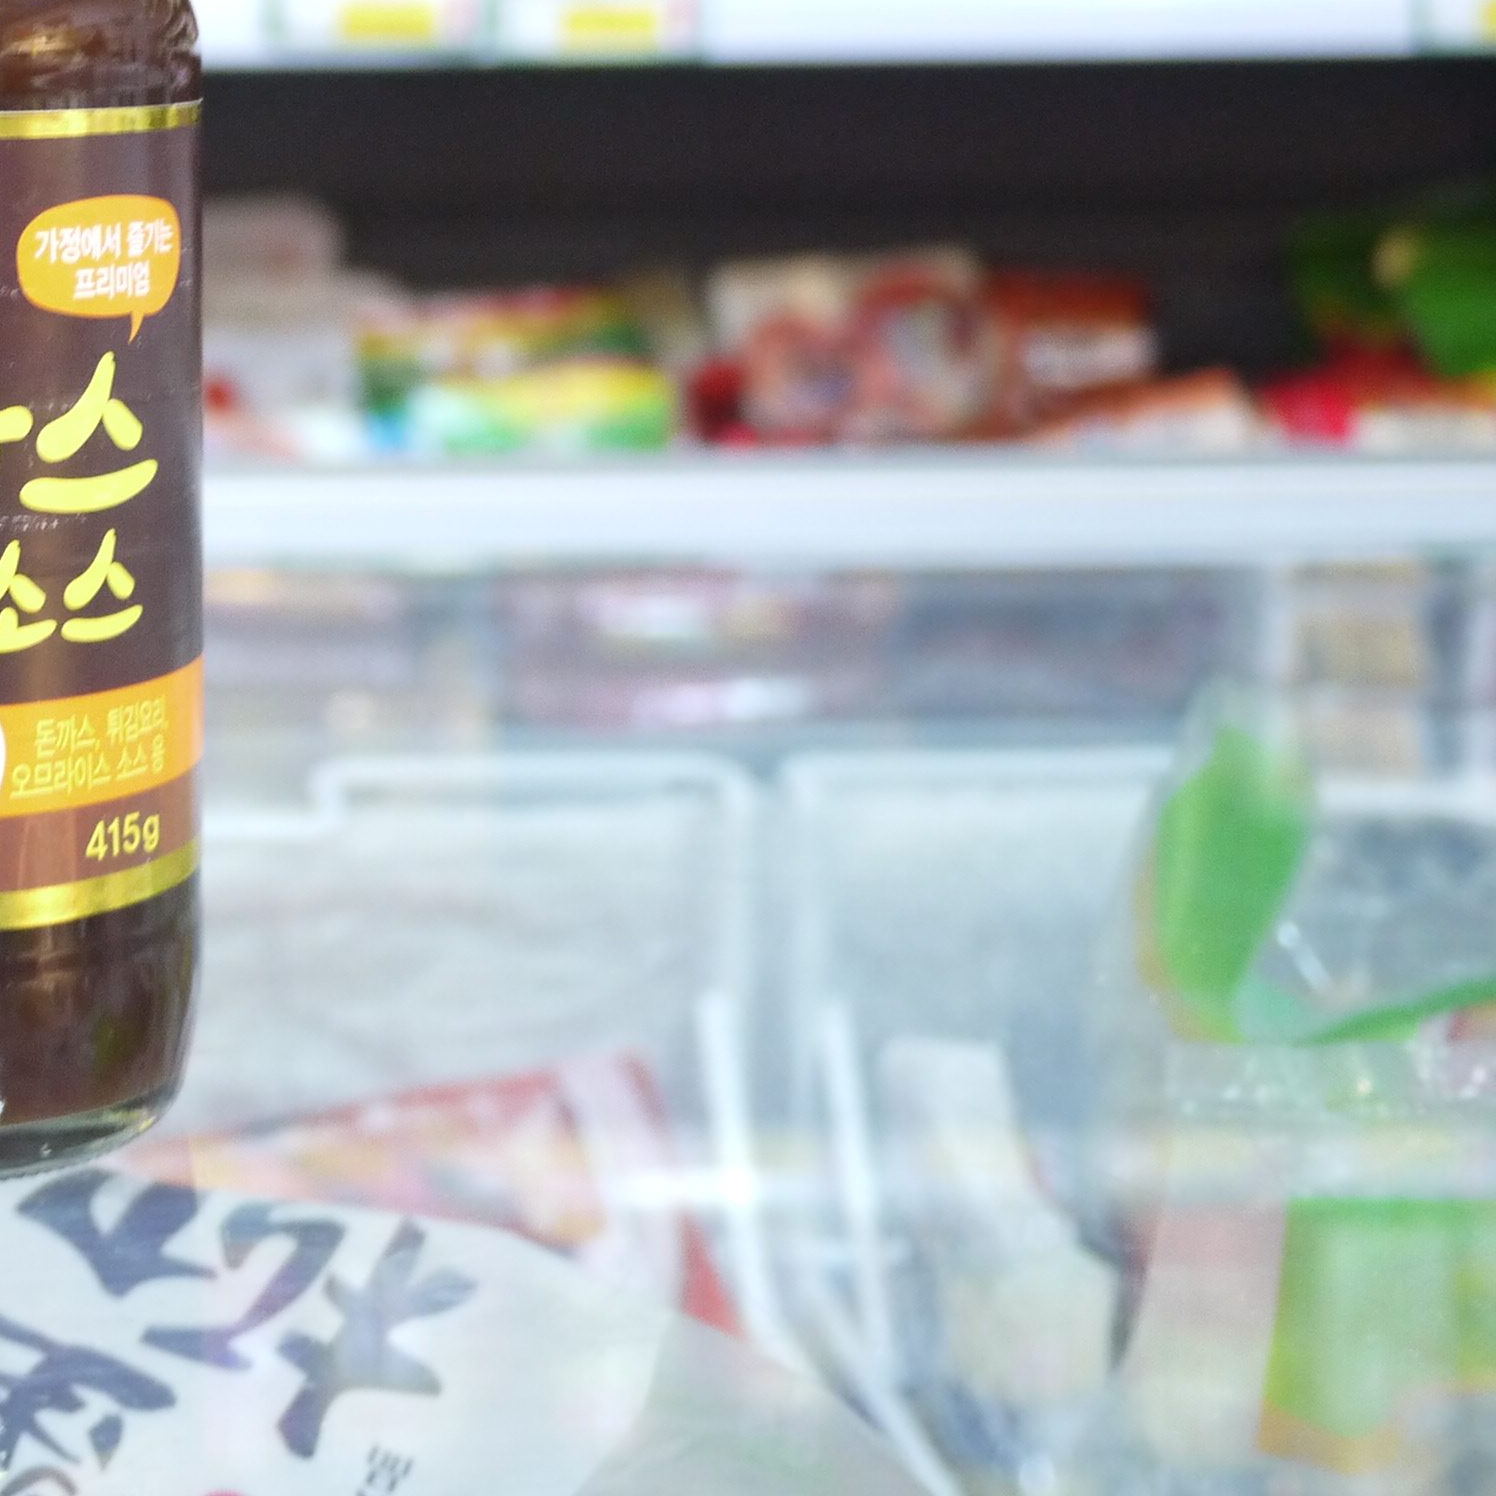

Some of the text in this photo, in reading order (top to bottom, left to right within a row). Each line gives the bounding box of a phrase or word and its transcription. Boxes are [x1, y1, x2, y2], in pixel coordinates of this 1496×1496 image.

[34, 216, 174, 264] 가정에서 즐기는
[72, 260, 152, 302] 프리미엄
[9, 752, 112, 800] 오므라이스
[85, 810, 161, 862] 415g
